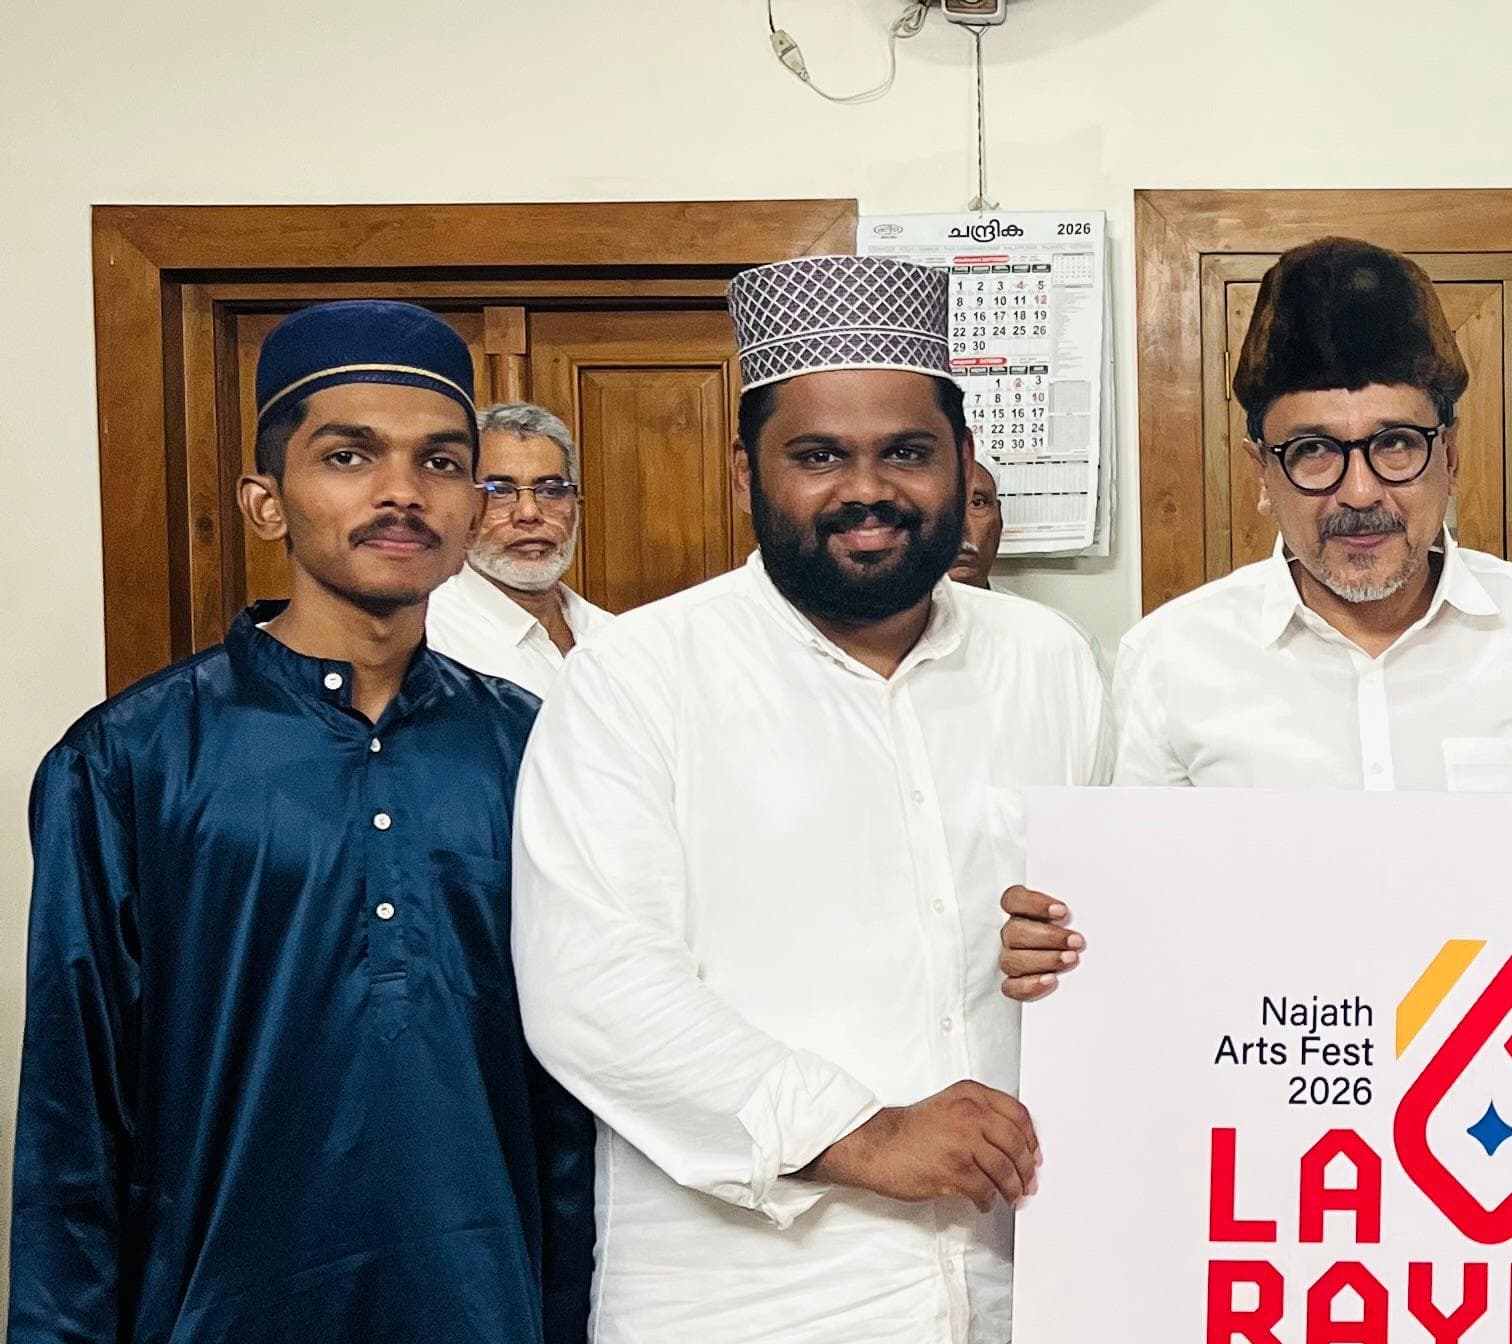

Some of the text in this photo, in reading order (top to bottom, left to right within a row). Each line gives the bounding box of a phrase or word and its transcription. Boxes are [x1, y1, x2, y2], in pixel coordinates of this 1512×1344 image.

[948, 218, 1024, 243] ചന്ദ്രിക
[1057, 222, 1091, 235] 2026
[957, 281, 1045, 292] 1 2 3 4 5
[956, 295, 1048, 307] 8 9 10 11 12
[954, 311, 1047, 321] 15 16 17 18 19
[953, 326, 1047, 337] 22 23 24 25 26
[953, 341, 986, 352] 29 30
[995, 376, 1042, 389] 1 2 3
[974, 393, 1045, 404] 7 8 9 10
[972, 408, 1045, 418] 14 15 16 17
[992, 424, 1005, 433] 22
[1012, 424, 1025, 433] 23
[1032, 423, 1045, 433] 24
[992, 440, 1005, 449] 29
[1012, 439, 1025, 448] 30
[1032, 438, 1044, 447] 31
[1262, 996, 1373, 1034] Najath
[1214, 1035, 1374, 1066] Arts Fest
[1288, 1076, 1372, 1106] 2026
[1209, 1127, 1383, 1244] LA
